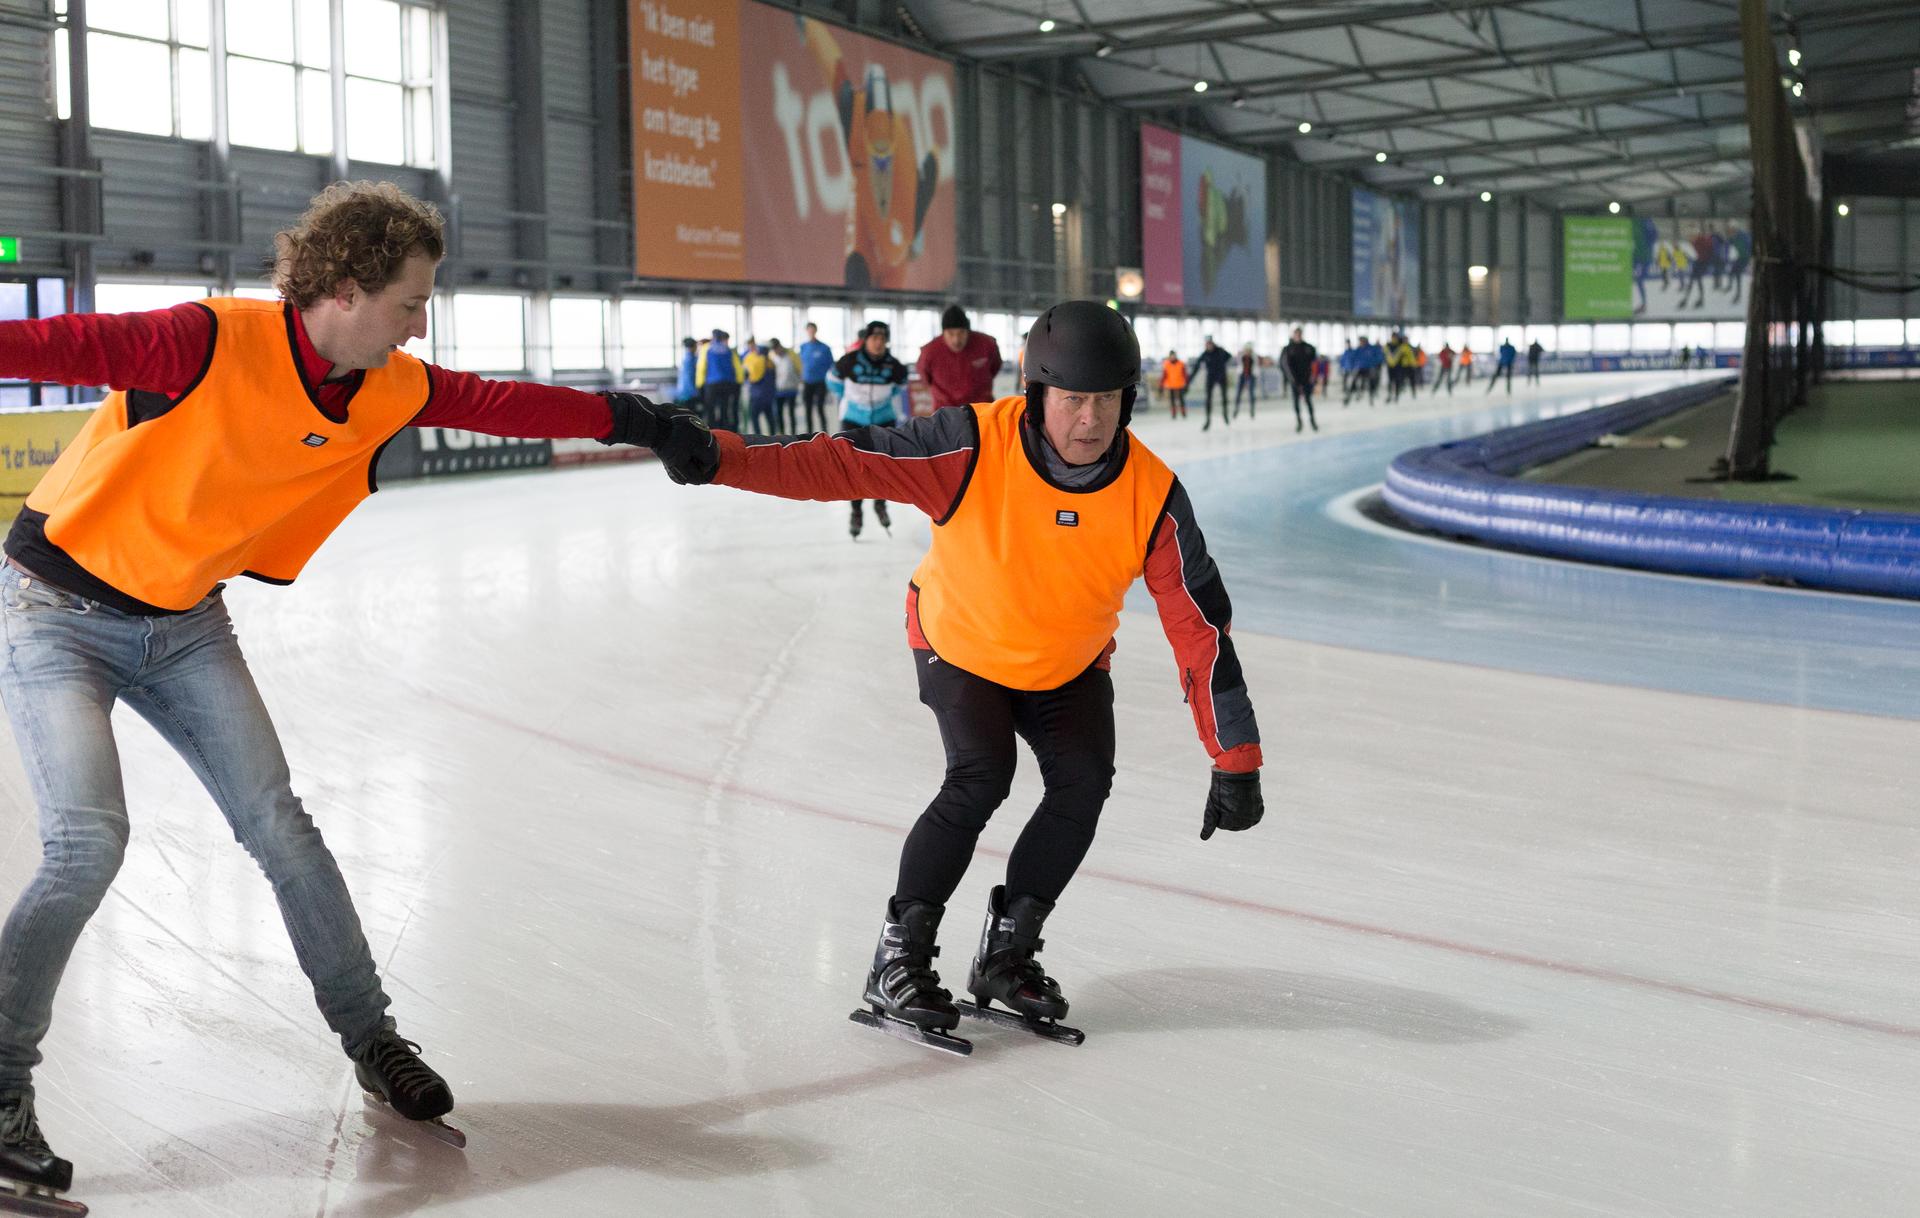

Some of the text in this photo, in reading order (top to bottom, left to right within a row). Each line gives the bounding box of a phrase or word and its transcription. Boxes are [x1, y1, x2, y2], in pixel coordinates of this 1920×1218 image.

[661, 4, 686, 40] ben
[687, 15, 715, 48] niet
[641, 49, 699, 97] het type
[668, 106, 704, 149] terug
[705, 114, 720, 143] te
